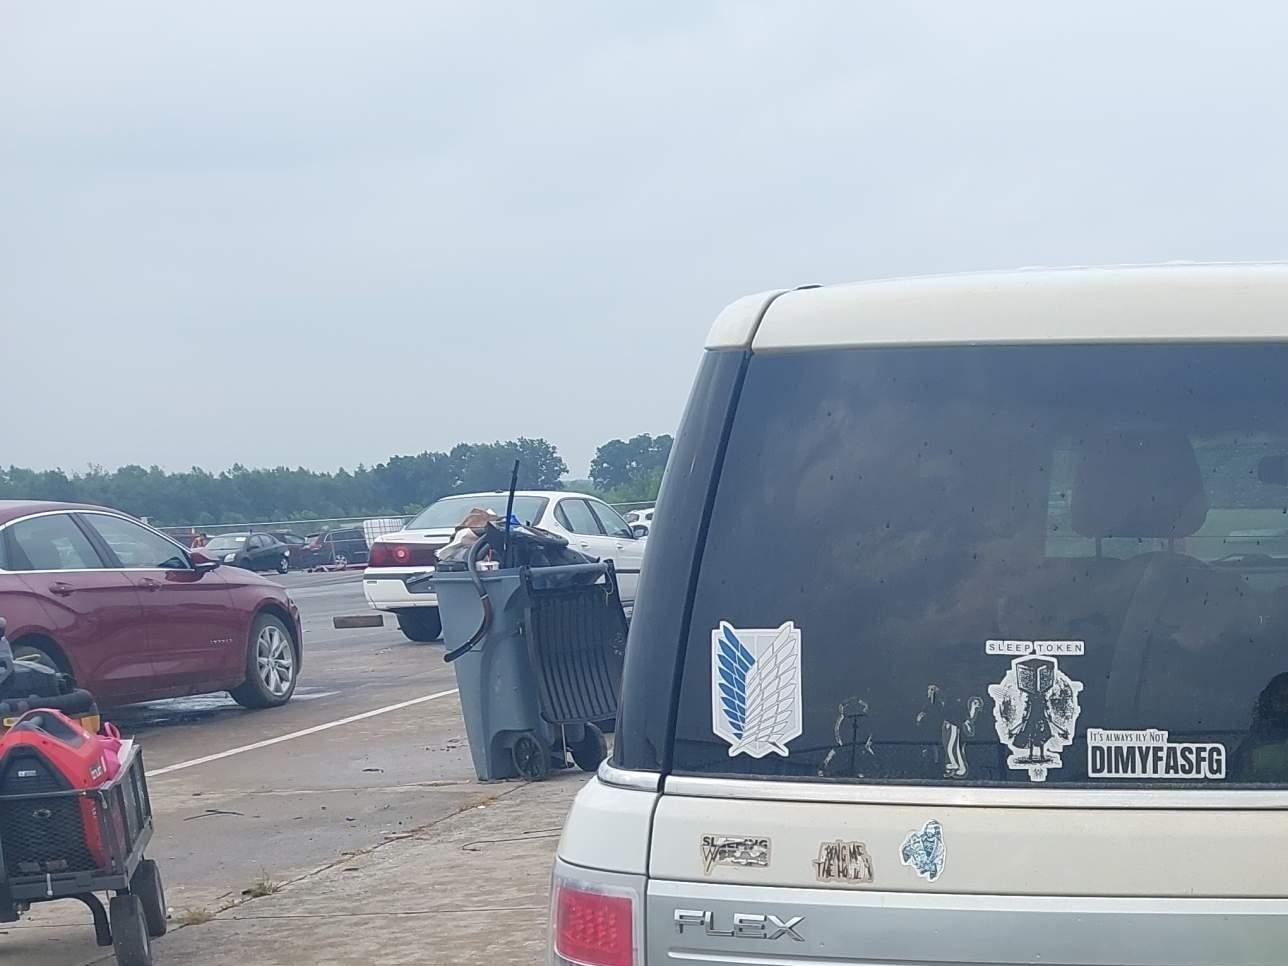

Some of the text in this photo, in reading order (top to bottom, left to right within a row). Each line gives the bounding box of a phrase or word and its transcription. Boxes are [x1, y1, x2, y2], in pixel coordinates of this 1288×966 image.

[988, 643, 1082, 653] SLEEP TOKEN
[1091, 745, 1222, 775] DIMYFASFG
[674, 908, 806, 943] FLEX
